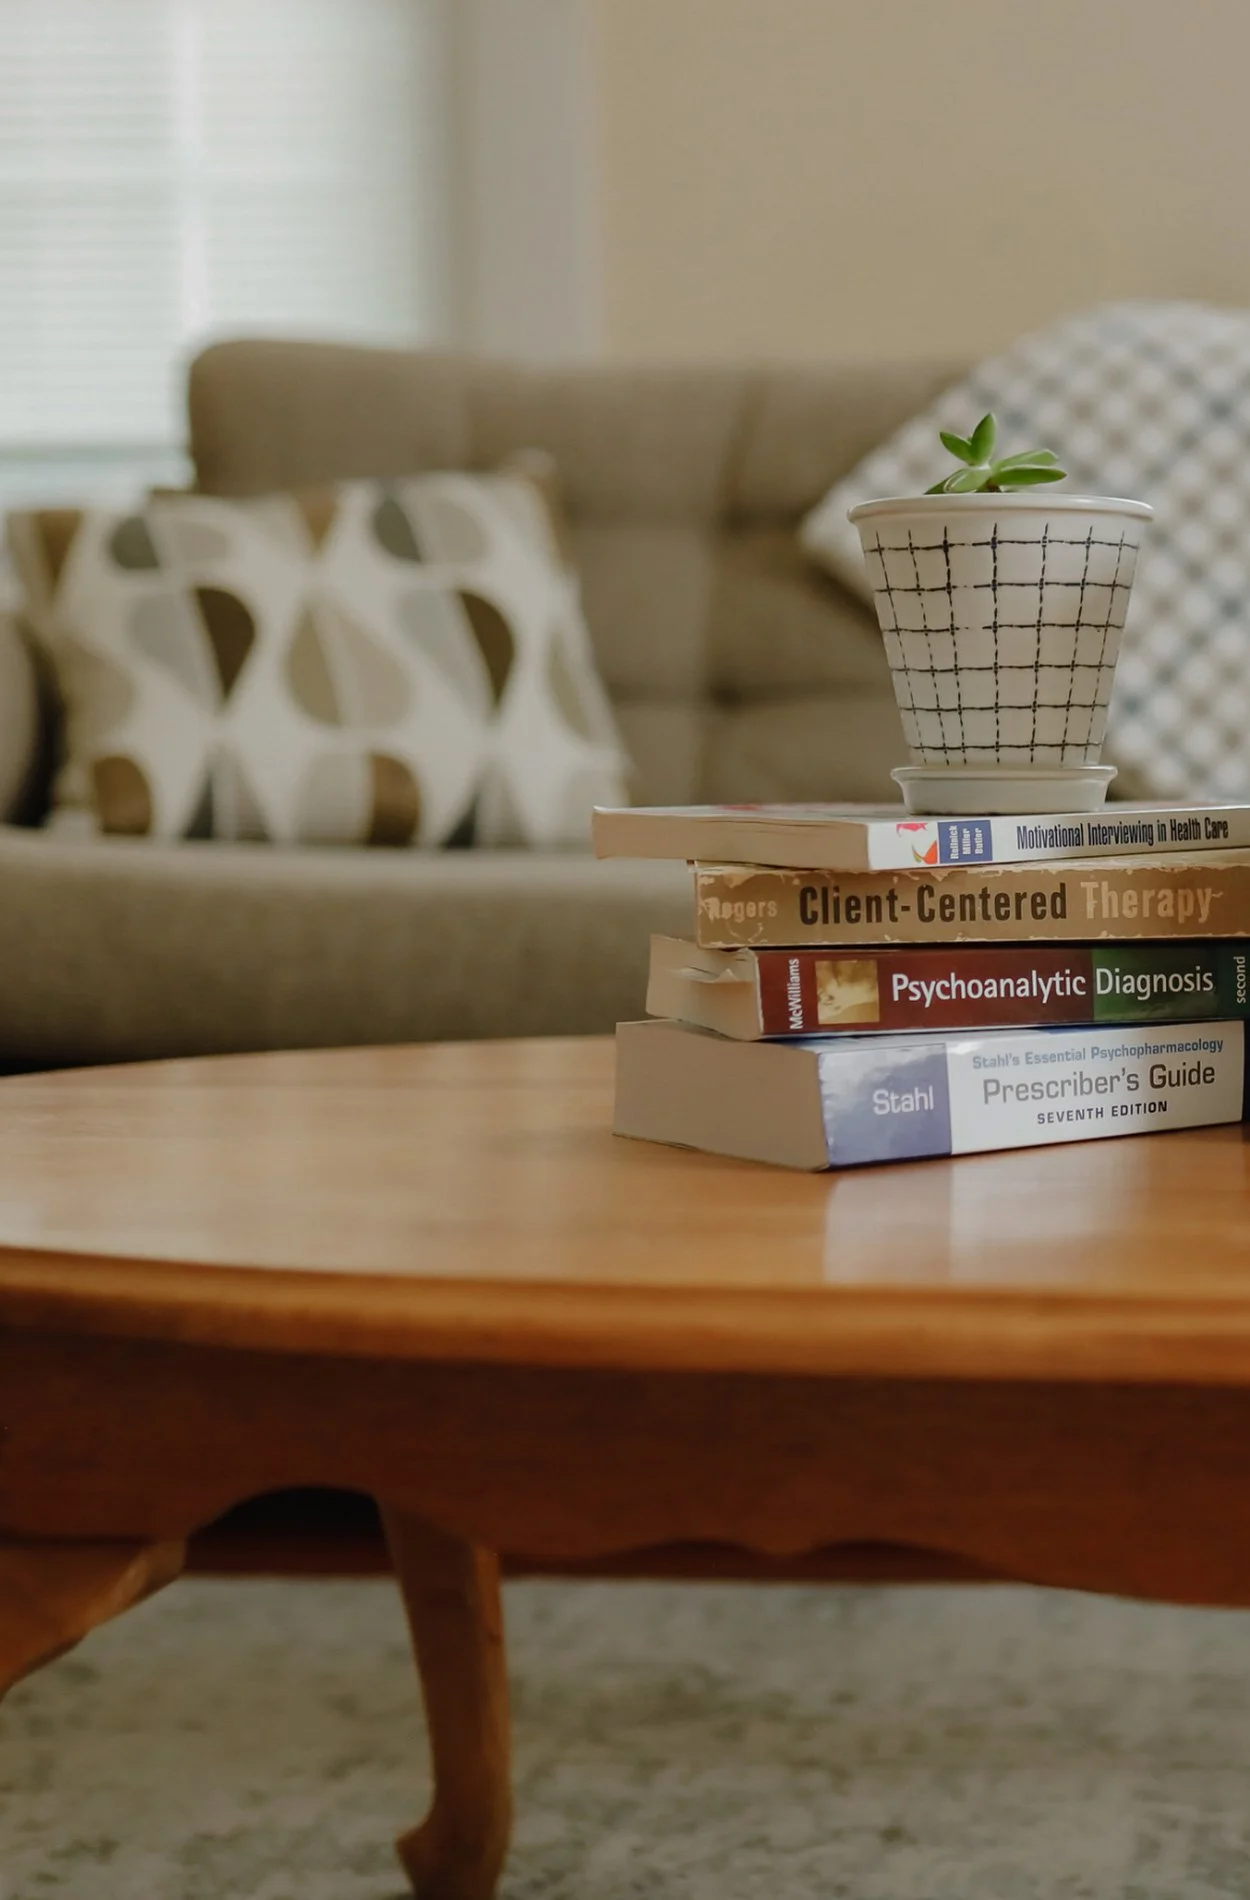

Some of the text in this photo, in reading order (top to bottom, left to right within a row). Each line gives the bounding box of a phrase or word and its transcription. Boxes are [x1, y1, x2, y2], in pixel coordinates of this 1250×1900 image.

[949, 825, 959, 859] Rollnick
[962, 828, 971, 855] Miller
[974, 827, 983, 854] Butler
[1016, 816, 1229, 850] Motivational Interviewing in Health Care
[704, 897, 778, 923] Rogers
[799, 880, 1213, 925] Client-Centered Therapy
[788, 957, 801, 1030] McWilliams
[892, 965, 1214, 1008] Psychoanalytic Diagnosis
[1233, 955, 1246, 1004] second
[971, 1038, 1224, 1070] Stahl's Essential Psychopharmacology
[872, 1085, 935, 1115] Stahl
[982, 1061, 1216, 1105] Prescriber's Guide
[1036, 1100, 1168, 1125] SEVENTH EDITION
